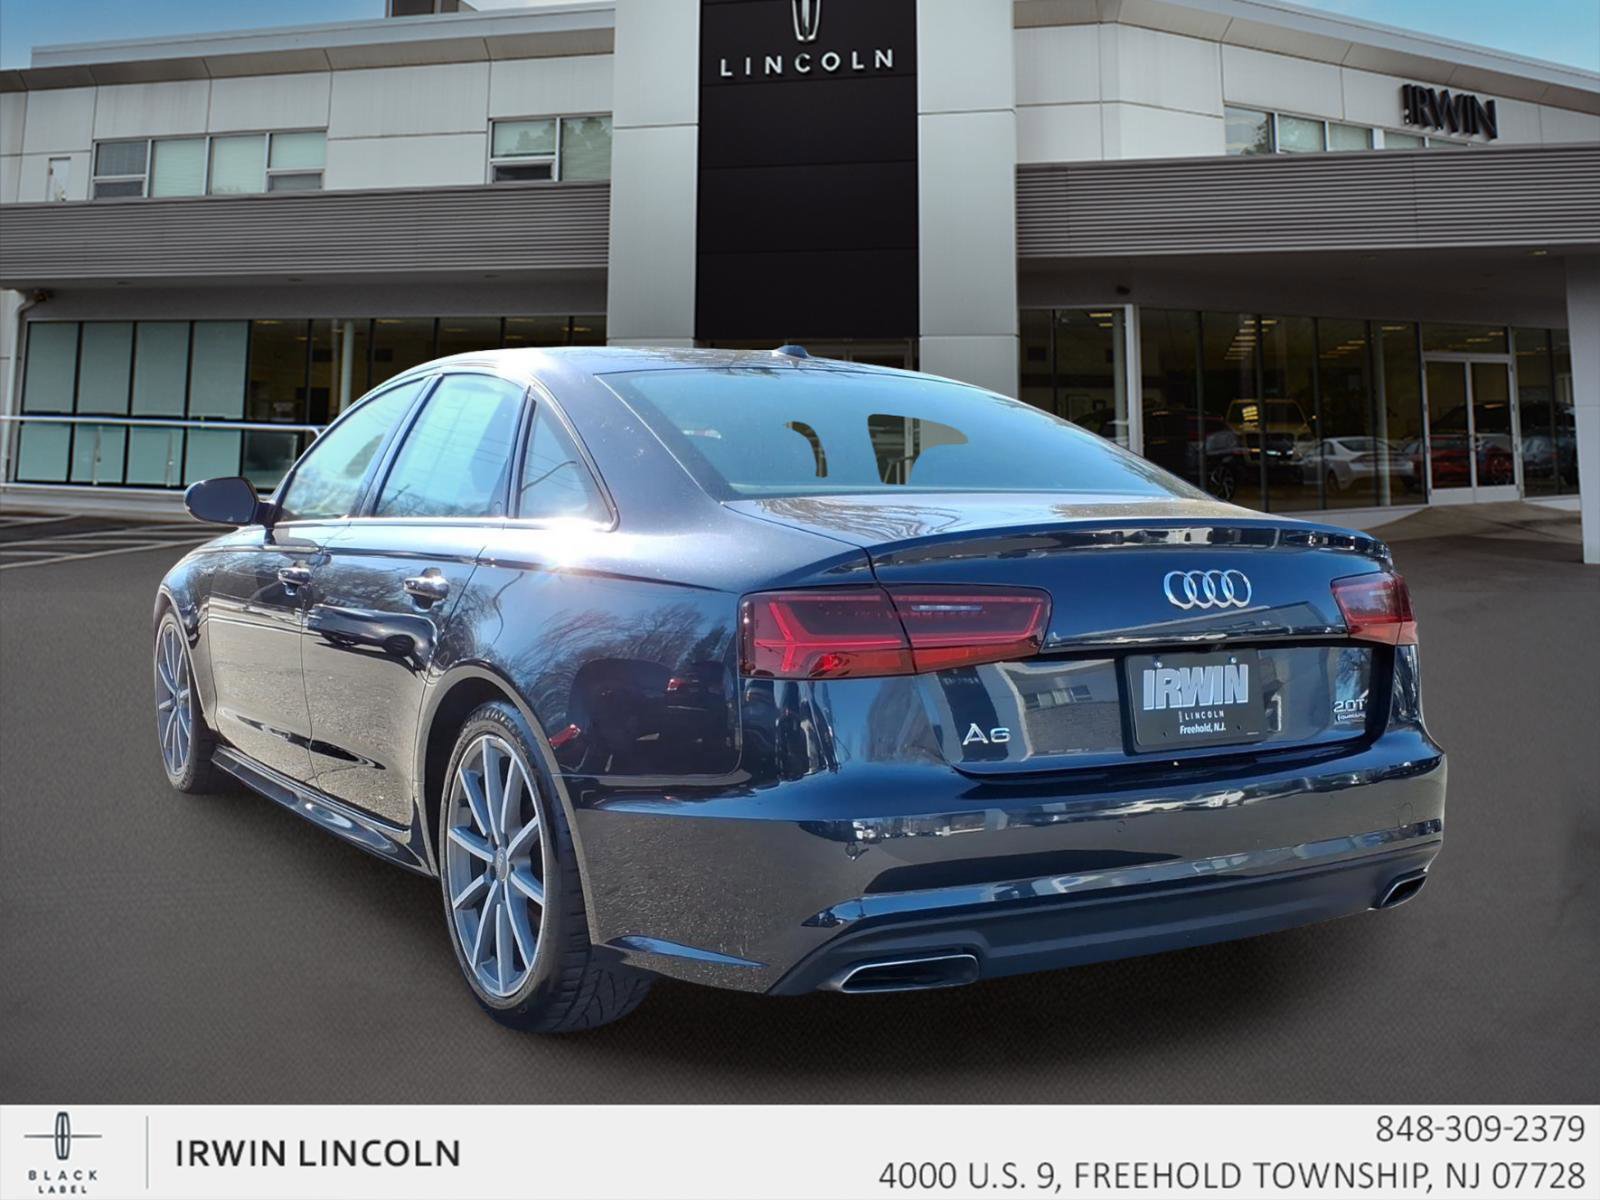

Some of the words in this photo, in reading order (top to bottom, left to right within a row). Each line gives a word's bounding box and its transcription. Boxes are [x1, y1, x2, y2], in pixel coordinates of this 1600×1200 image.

[720, 49, 894, 77] LINCOLN
[1401, 84, 1498, 140] IRWIN
[1143, 664, 1249, 710] IRWIN
[1184, 709, 1225, 721] LINCOLN
[962, 722, 1011, 746] A6
[1179, 722, 1213, 735] Freehold,
